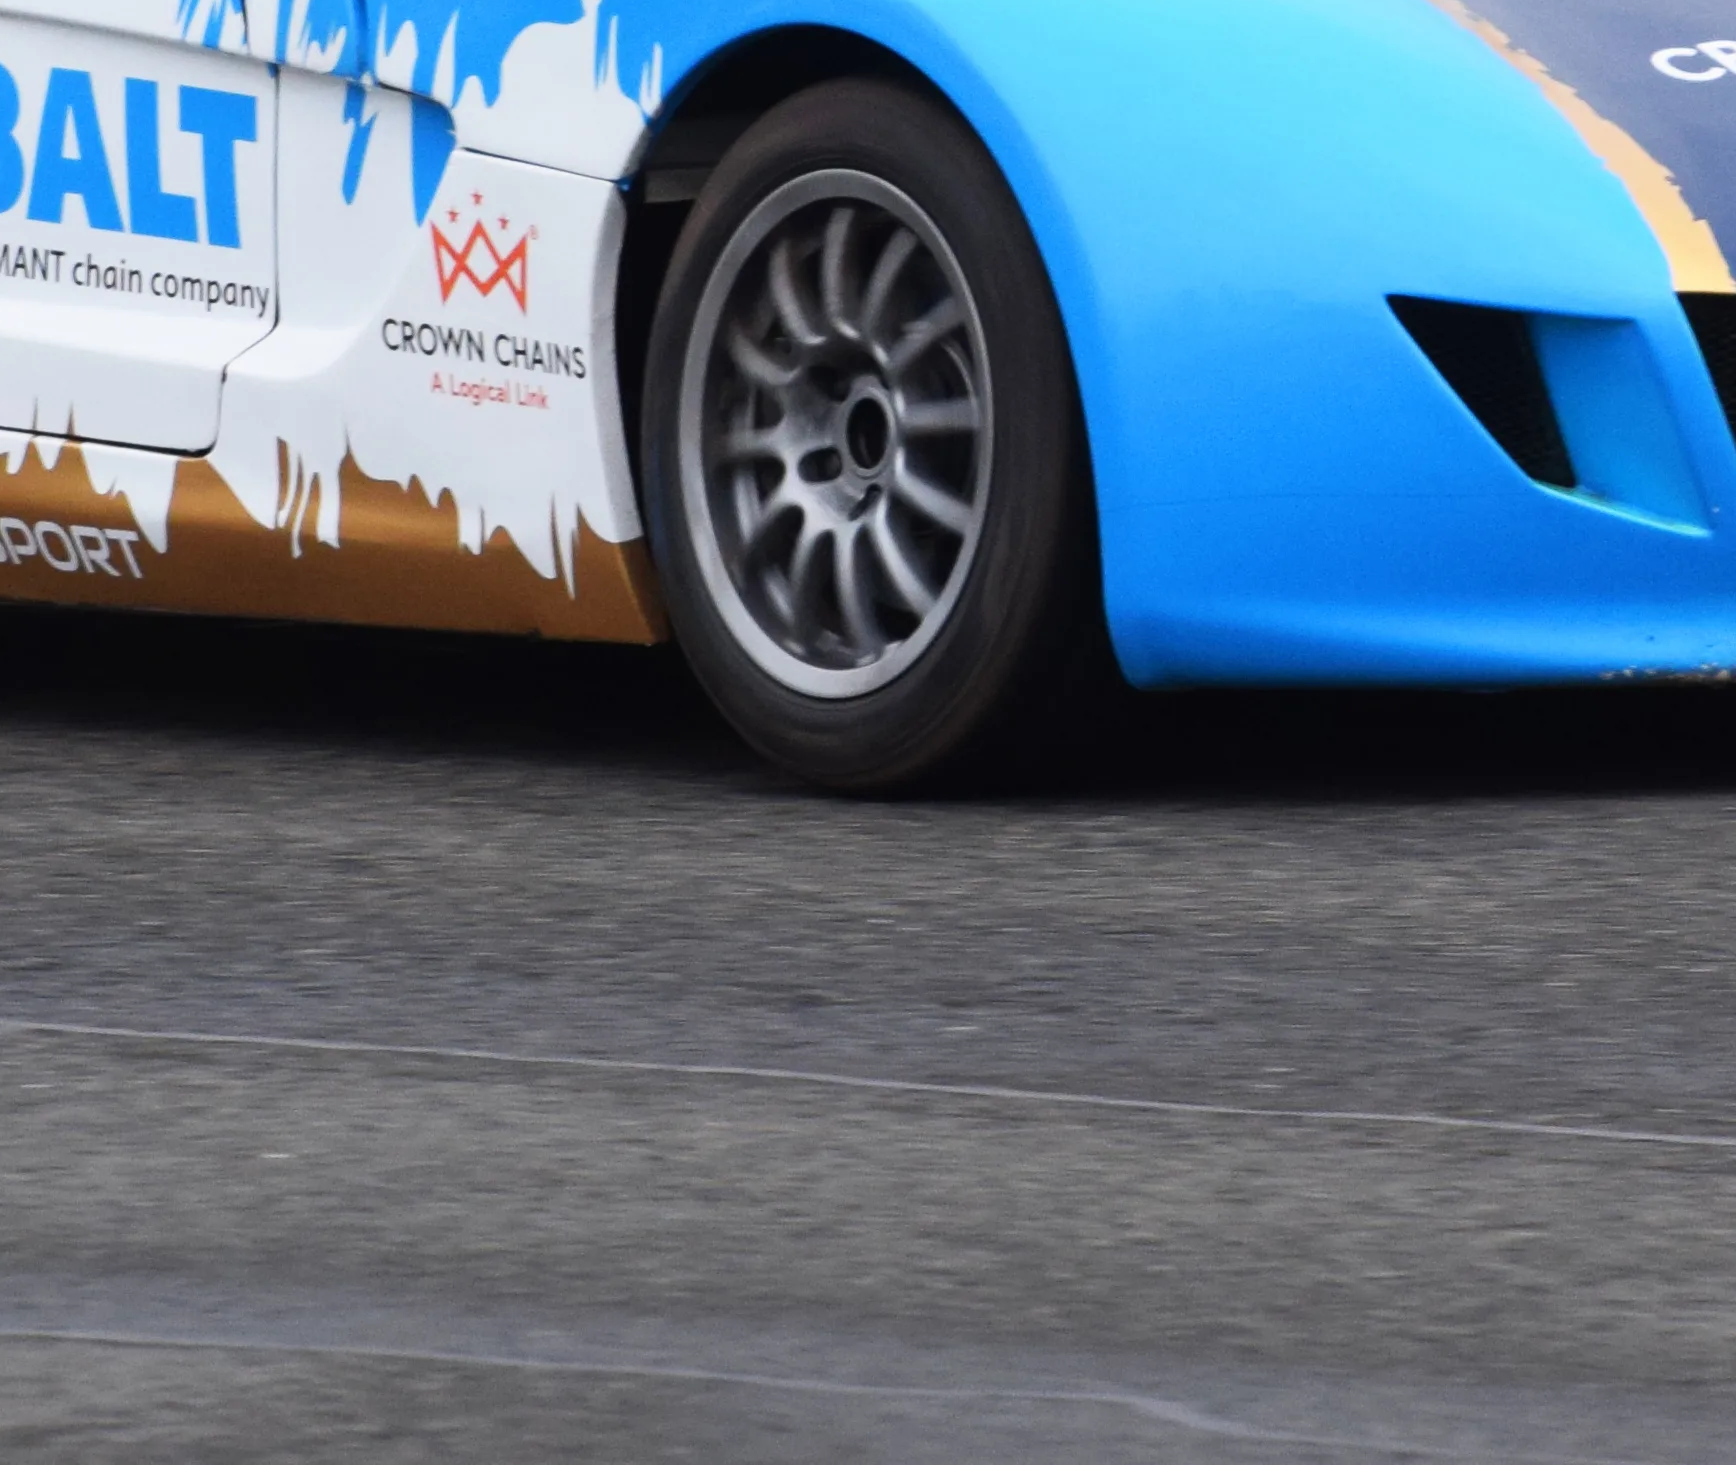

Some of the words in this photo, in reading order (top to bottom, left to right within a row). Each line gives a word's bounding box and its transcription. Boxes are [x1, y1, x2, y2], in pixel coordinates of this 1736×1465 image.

[72, 253, 142, 294] chain
[150, 271, 269, 319] company
[382, 318, 485, 363] CROWN
[494, 333, 587, 379] CHAINS
[430, 372, 445, 393] A
[450, 374, 511, 406] Logical
[517, 383, 550, 410] Link
